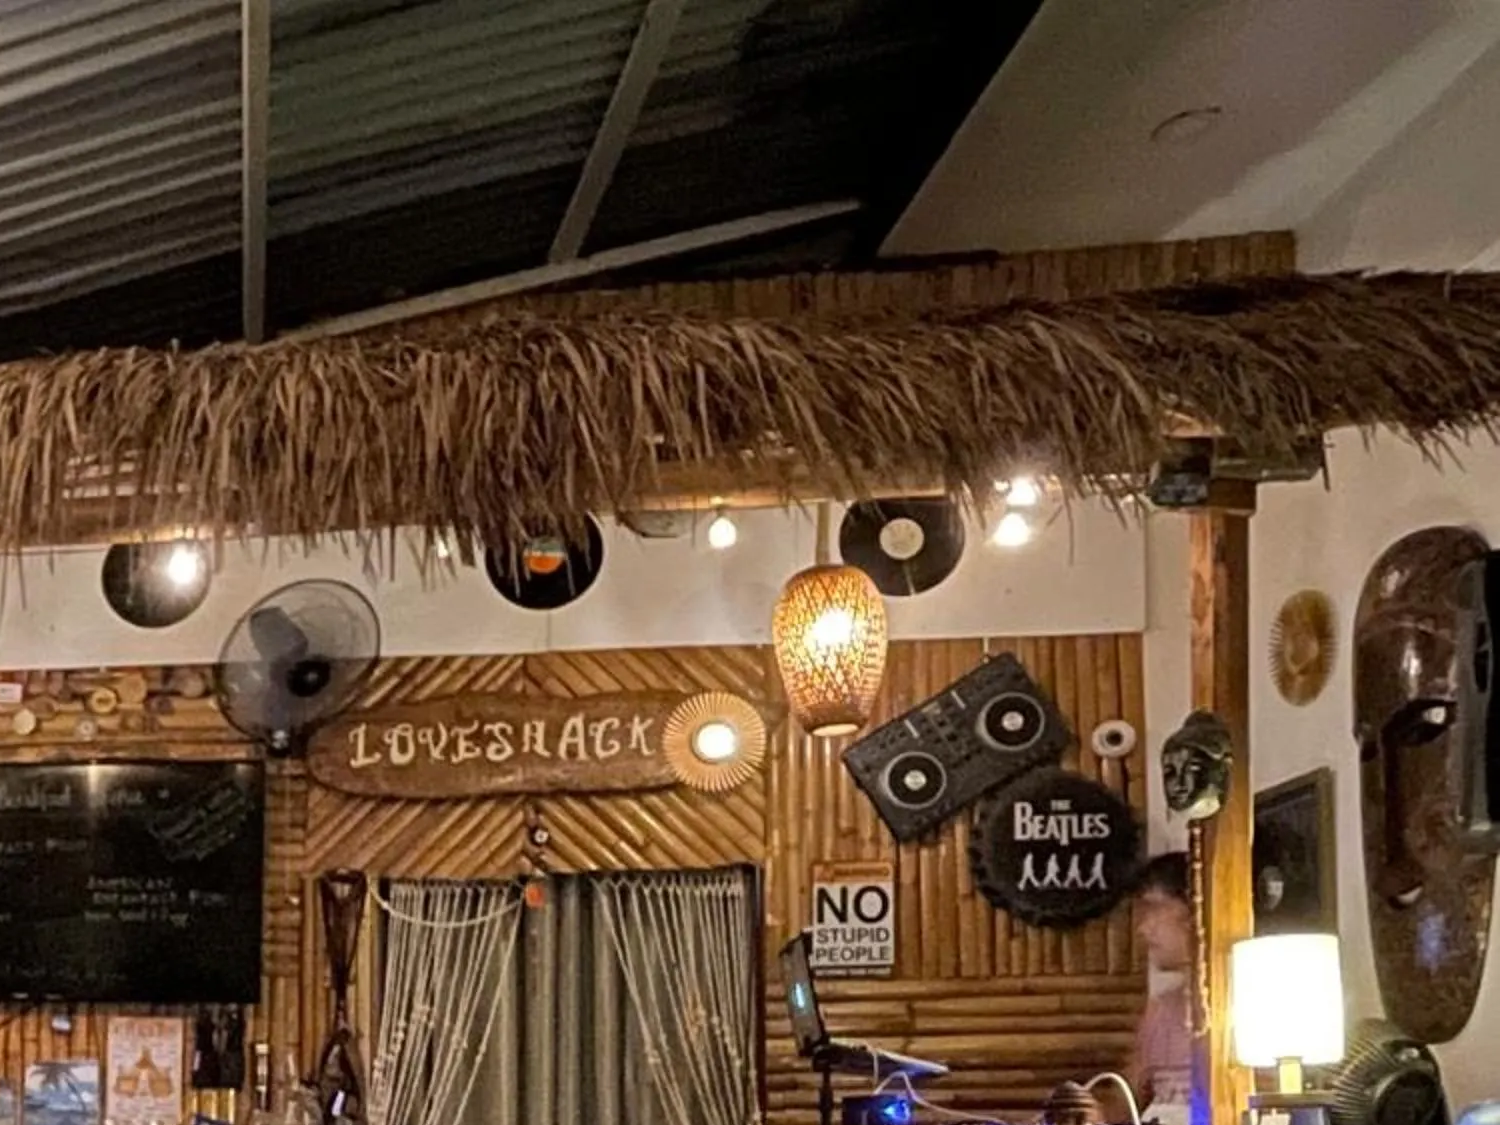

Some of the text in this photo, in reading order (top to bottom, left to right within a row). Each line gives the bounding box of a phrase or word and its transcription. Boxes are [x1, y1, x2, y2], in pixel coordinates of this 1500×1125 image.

[347, 712, 657, 769] LOVESHACK
[1013, 801, 1112, 847] BEATLES
[816, 885, 890, 924] NO
[815, 946, 890, 962] PEOPLE
[816, 927, 890, 944] STUPID
